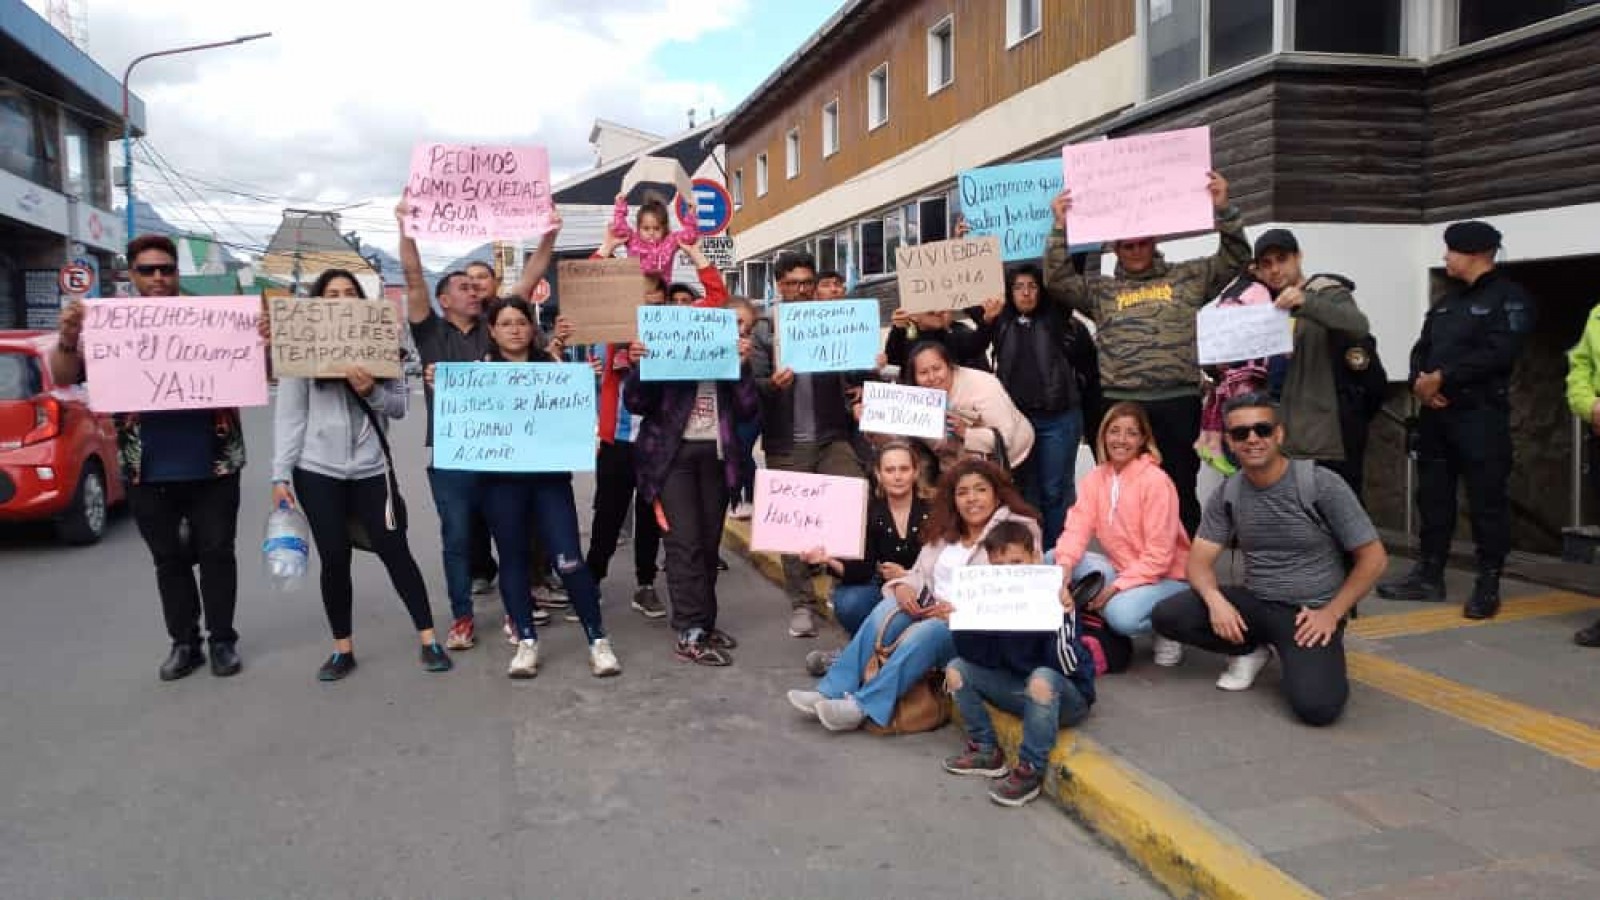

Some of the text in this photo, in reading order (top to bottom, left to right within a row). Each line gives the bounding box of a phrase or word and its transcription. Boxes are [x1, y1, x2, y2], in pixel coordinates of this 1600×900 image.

[411, 173, 546, 201] COMO SOCIEDAD
[431, 202, 479, 221] AGUA
[691, 190, 716, 228] E
[898, 241, 993, 269] VIVIENDA
[909, 269, 985, 294] DIGNA
[273, 300, 393, 324] BASTA DE
[947, 293, 970, 308] YA
[90, 305, 196, 330] DERECHOS
[275, 324, 396, 342] ALQUILERES
[93, 344, 121, 360] EN
[274, 344, 400, 362] TEMPORARIOS
[144, 371, 215, 403] YA!!!
